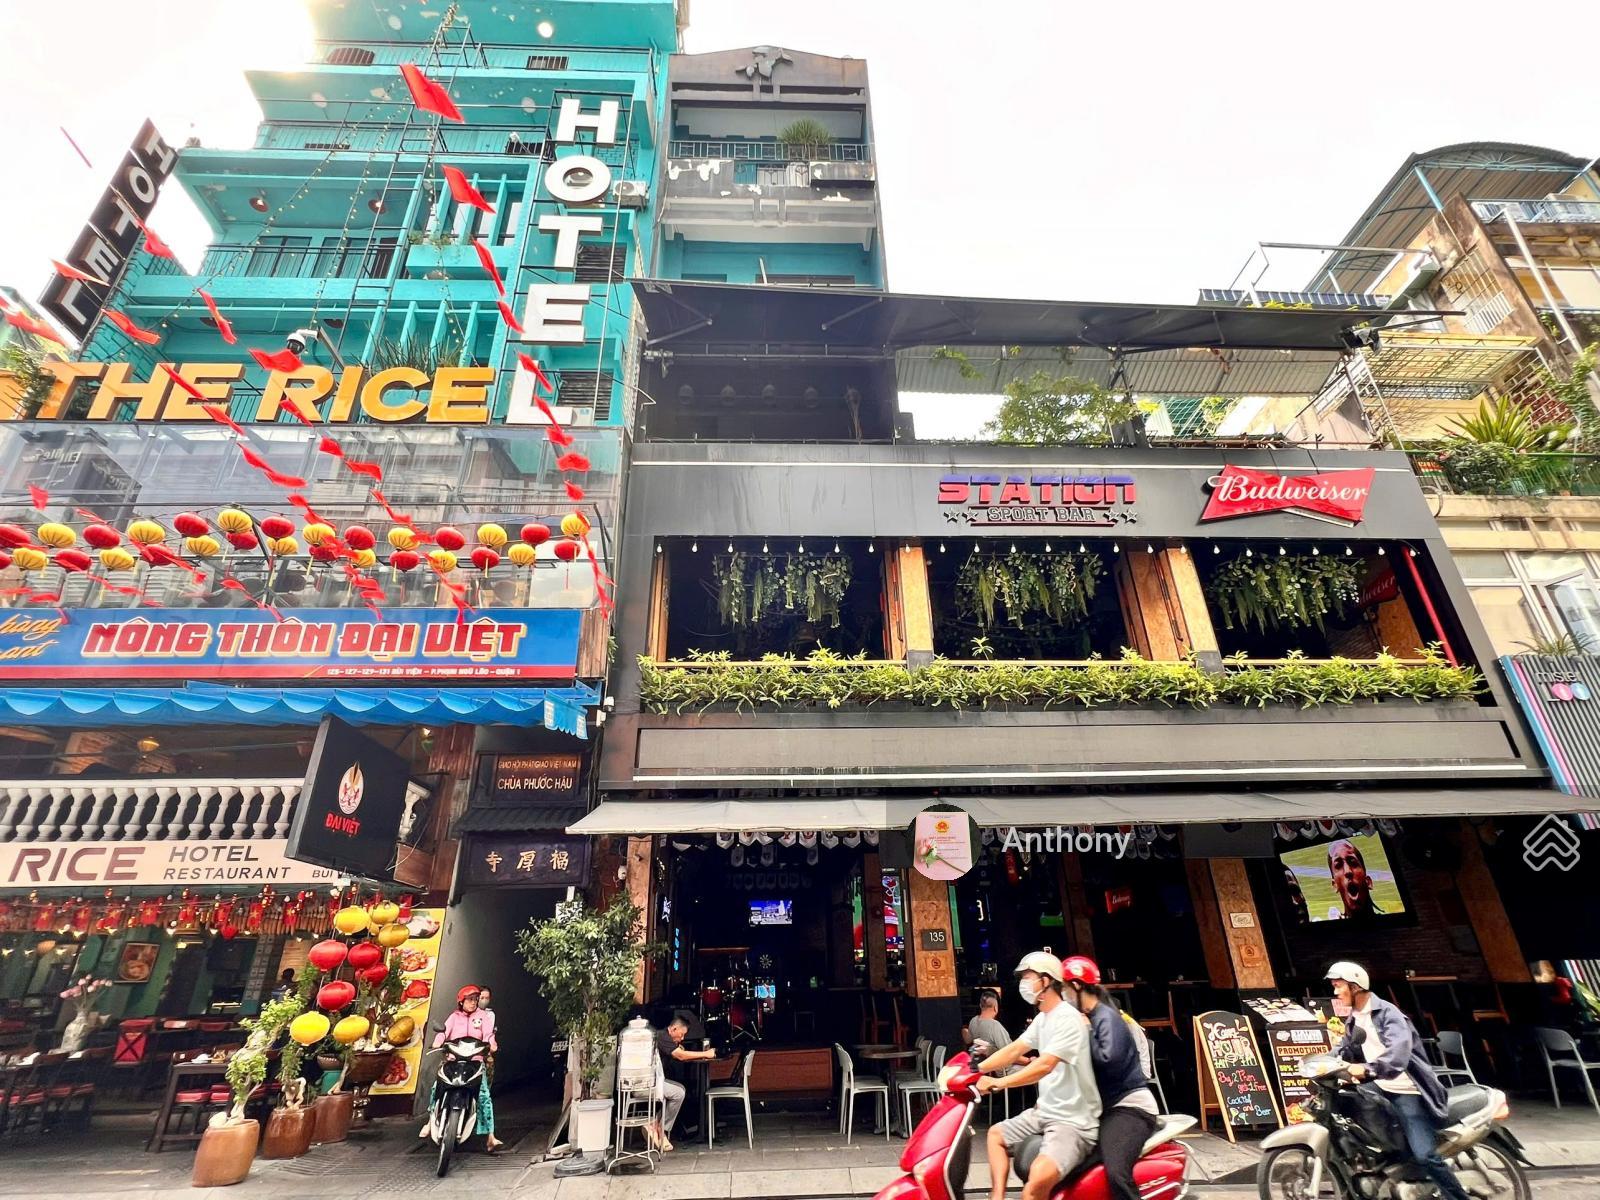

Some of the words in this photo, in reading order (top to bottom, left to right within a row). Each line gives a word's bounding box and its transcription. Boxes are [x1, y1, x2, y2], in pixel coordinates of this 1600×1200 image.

[60, 129, 174, 326] HOTEL
[505, 97, 619, 425] HOTEL
[38, 362, 244, 422] THE
[256, 365, 496, 424] RICE
[938, 474, 1136, 504] STATION
[1207, 475, 1369, 502] Budweiser
[987, 507, 1049, 522] SPORT
[1056, 507, 1096, 523] BAR
[81, 616, 212, 657] NÔNG
[217, 616, 337, 657] THÔN
[337, 623, 420, 662] ĐẠI
[498, 774, 521, 790] CHÙA
[523, 773, 553, 790] PHƯỚC
[554, 775, 573, 791] HẬU
[8, 847, 146, 882] RICE
[168, 845, 259, 863] HOTEL
[163, 867, 291, 880] RESTAURANT
[312, 869, 334, 878] BUI
[929, 931, 945, 942] 135
[1278, 1046, 1328, 1056] PROMOTIONS
